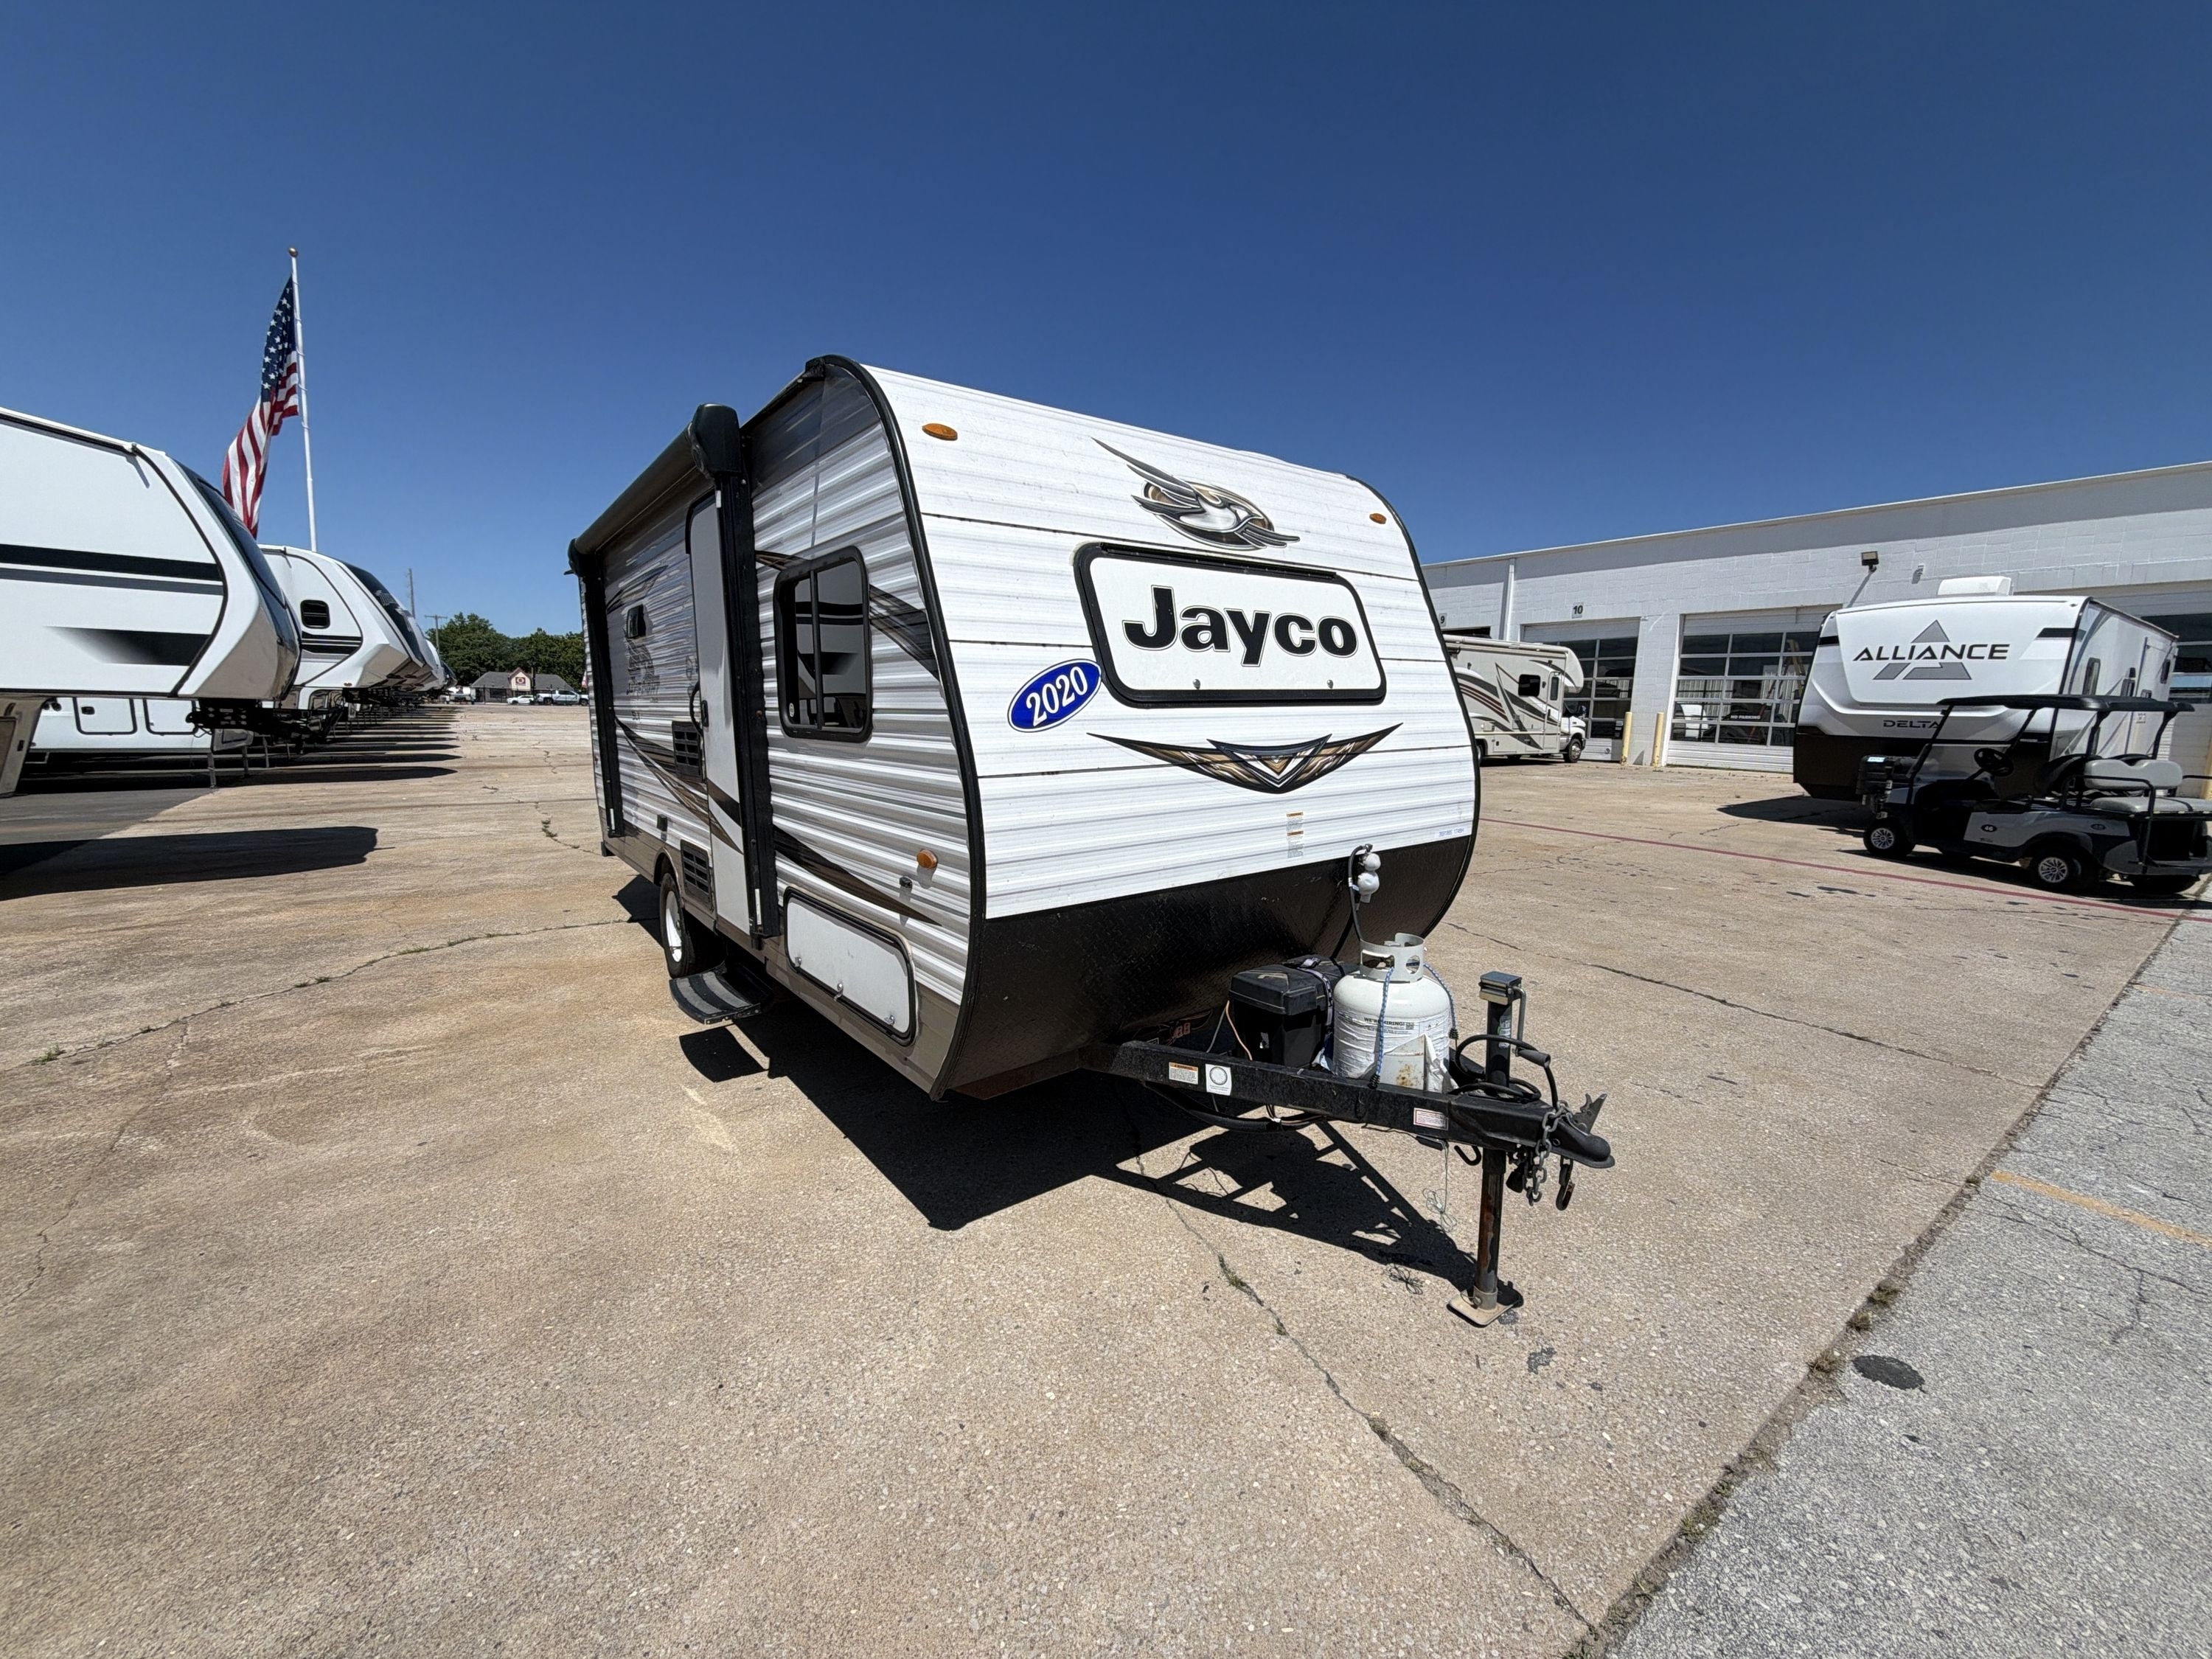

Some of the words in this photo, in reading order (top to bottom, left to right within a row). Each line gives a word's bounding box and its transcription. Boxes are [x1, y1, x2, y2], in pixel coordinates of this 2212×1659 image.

[1573, 605, 1583, 614] 10
[1121, 585, 1359, 667] Jayco
[1440, 615, 1445, 624] 9
[1852, 644, 2011, 661] ALLIANCE
[1026, 666, 1088, 727] 2020
[1883, 720, 1941, 728] DELTA
